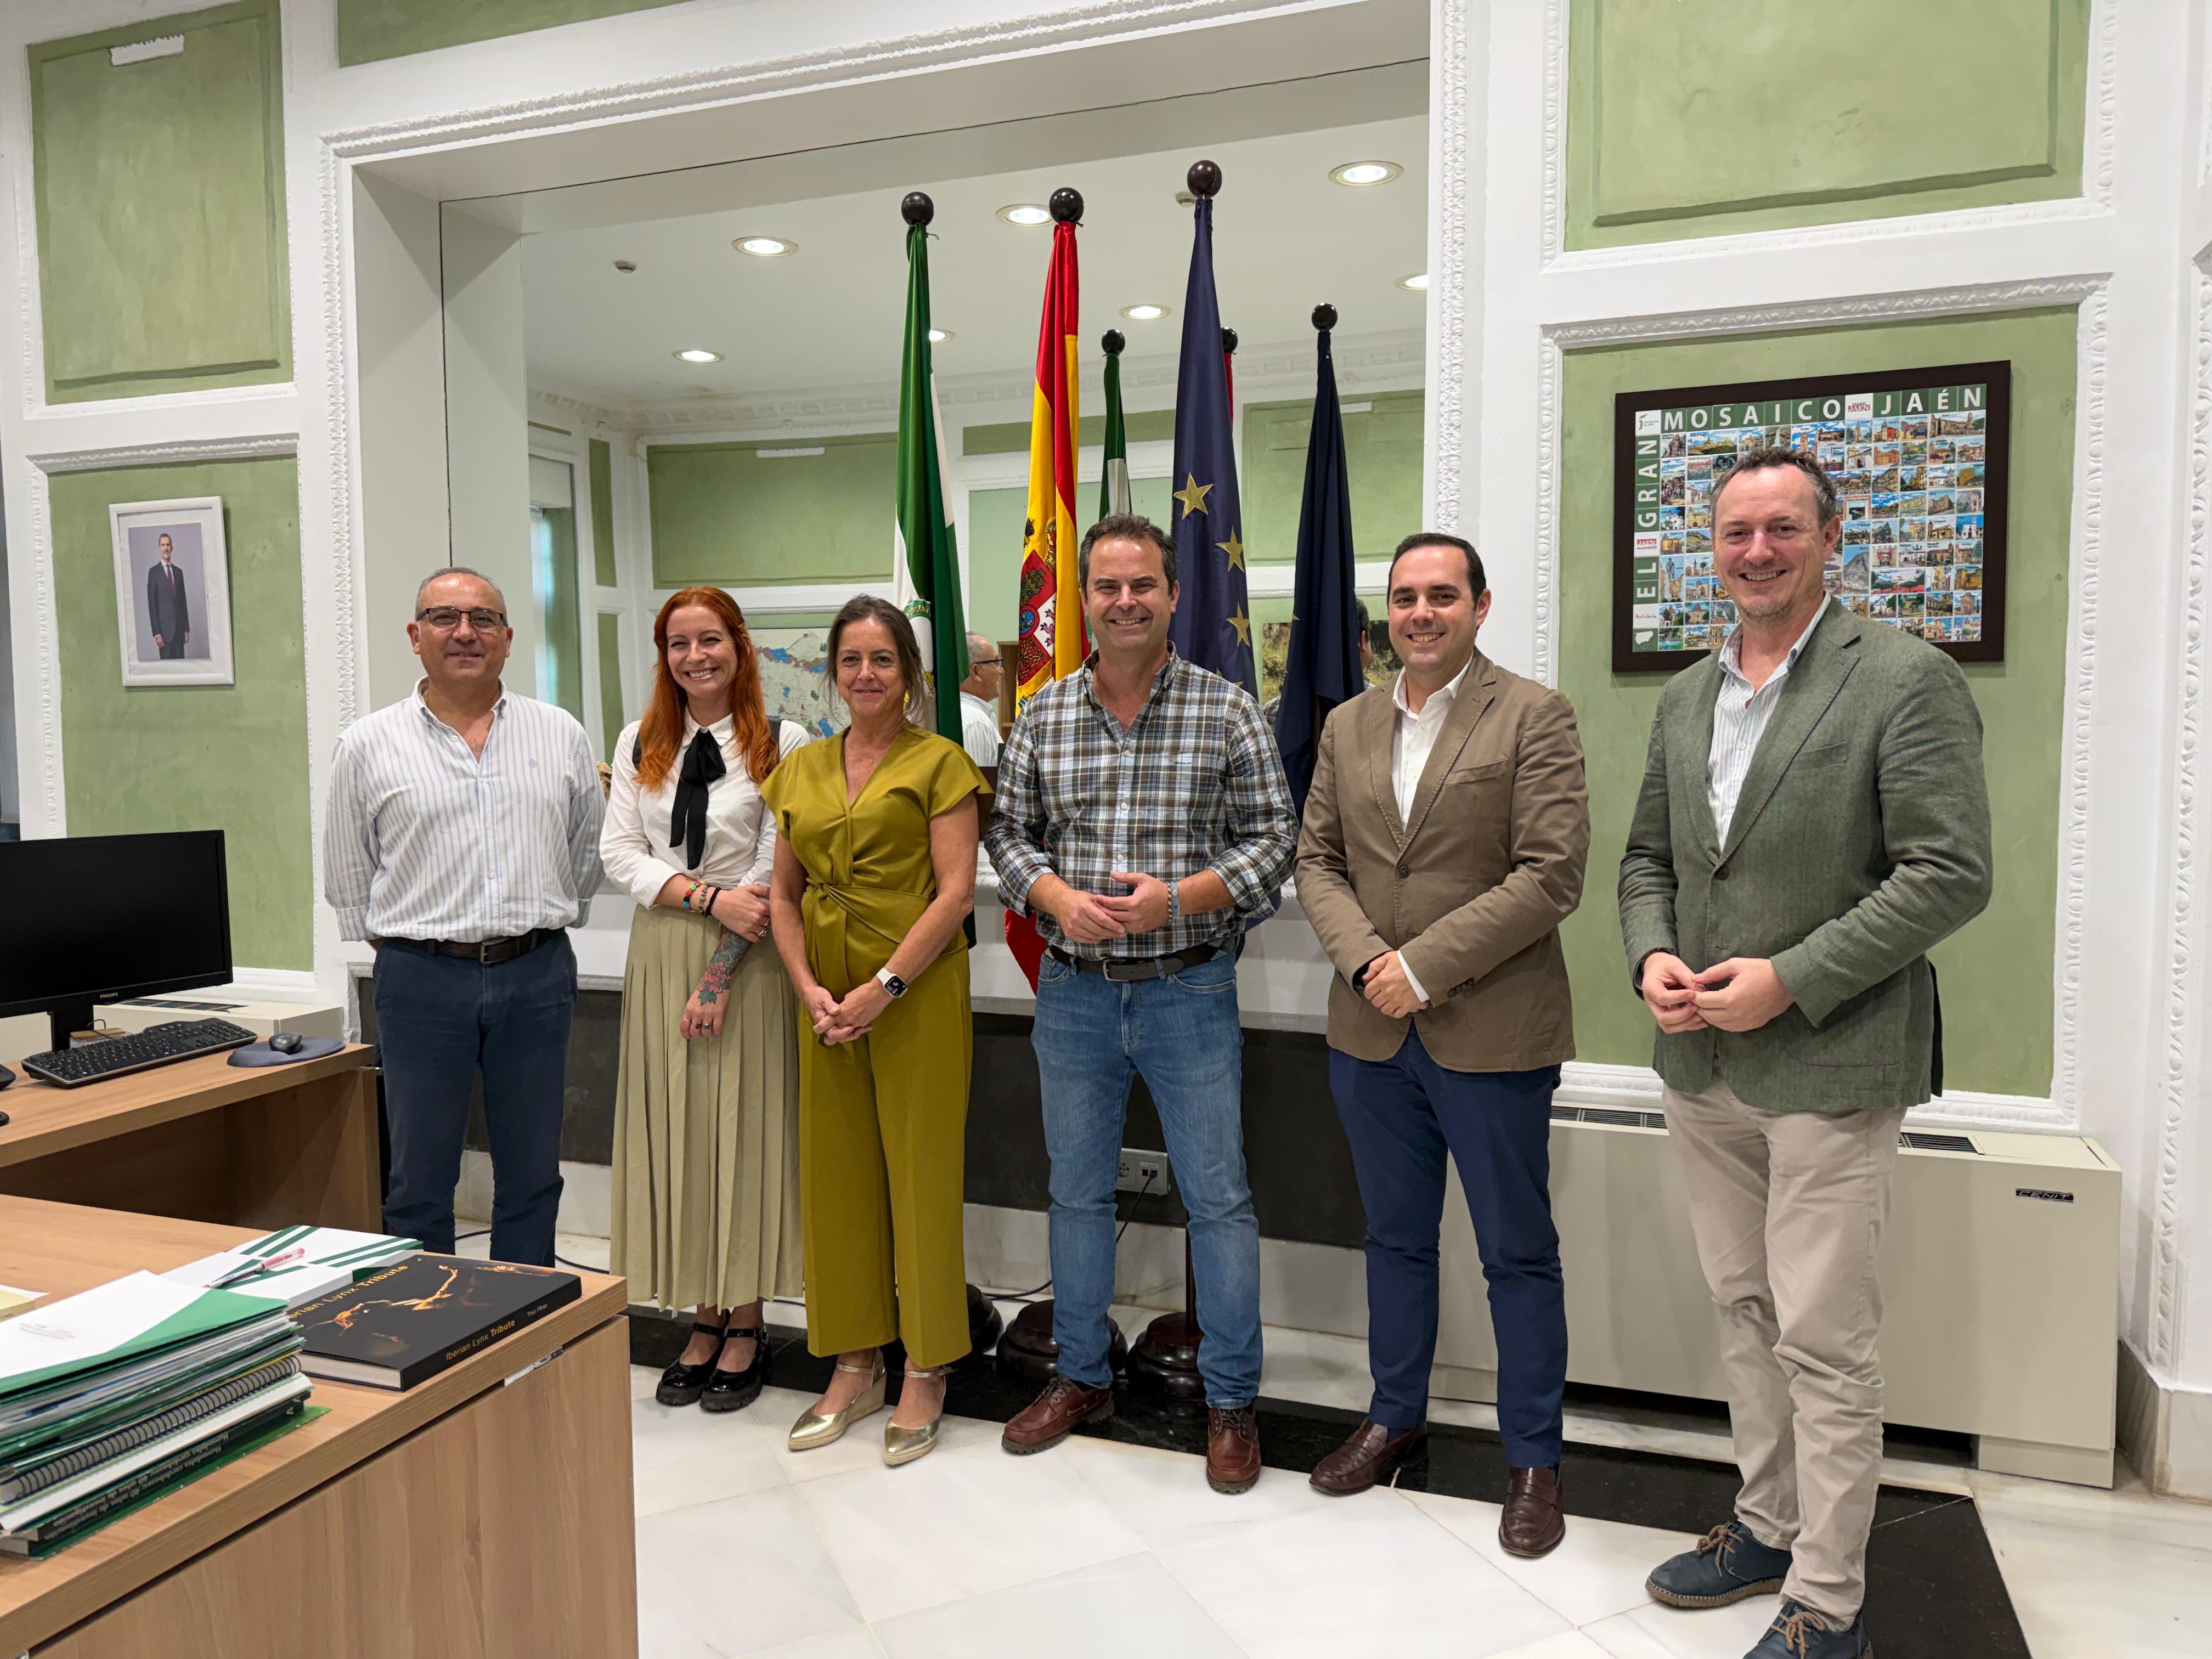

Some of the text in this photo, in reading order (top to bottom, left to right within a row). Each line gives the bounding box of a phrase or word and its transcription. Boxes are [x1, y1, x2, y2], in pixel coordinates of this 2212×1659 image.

[1664, 399, 1841, 431] MOSAICO
[1881, 387, 1981, 415] JAÉN
[1638, 439, 1658, 528] GRAN
[1637, 562, 1656, 597] EL
[2018, 1190, 2070, 1200] CENIT
[289, 1265, 408, 1319] erian Lynx Tribute
[446, 1319, 515, 1361] Iberian Lynx Tribute
